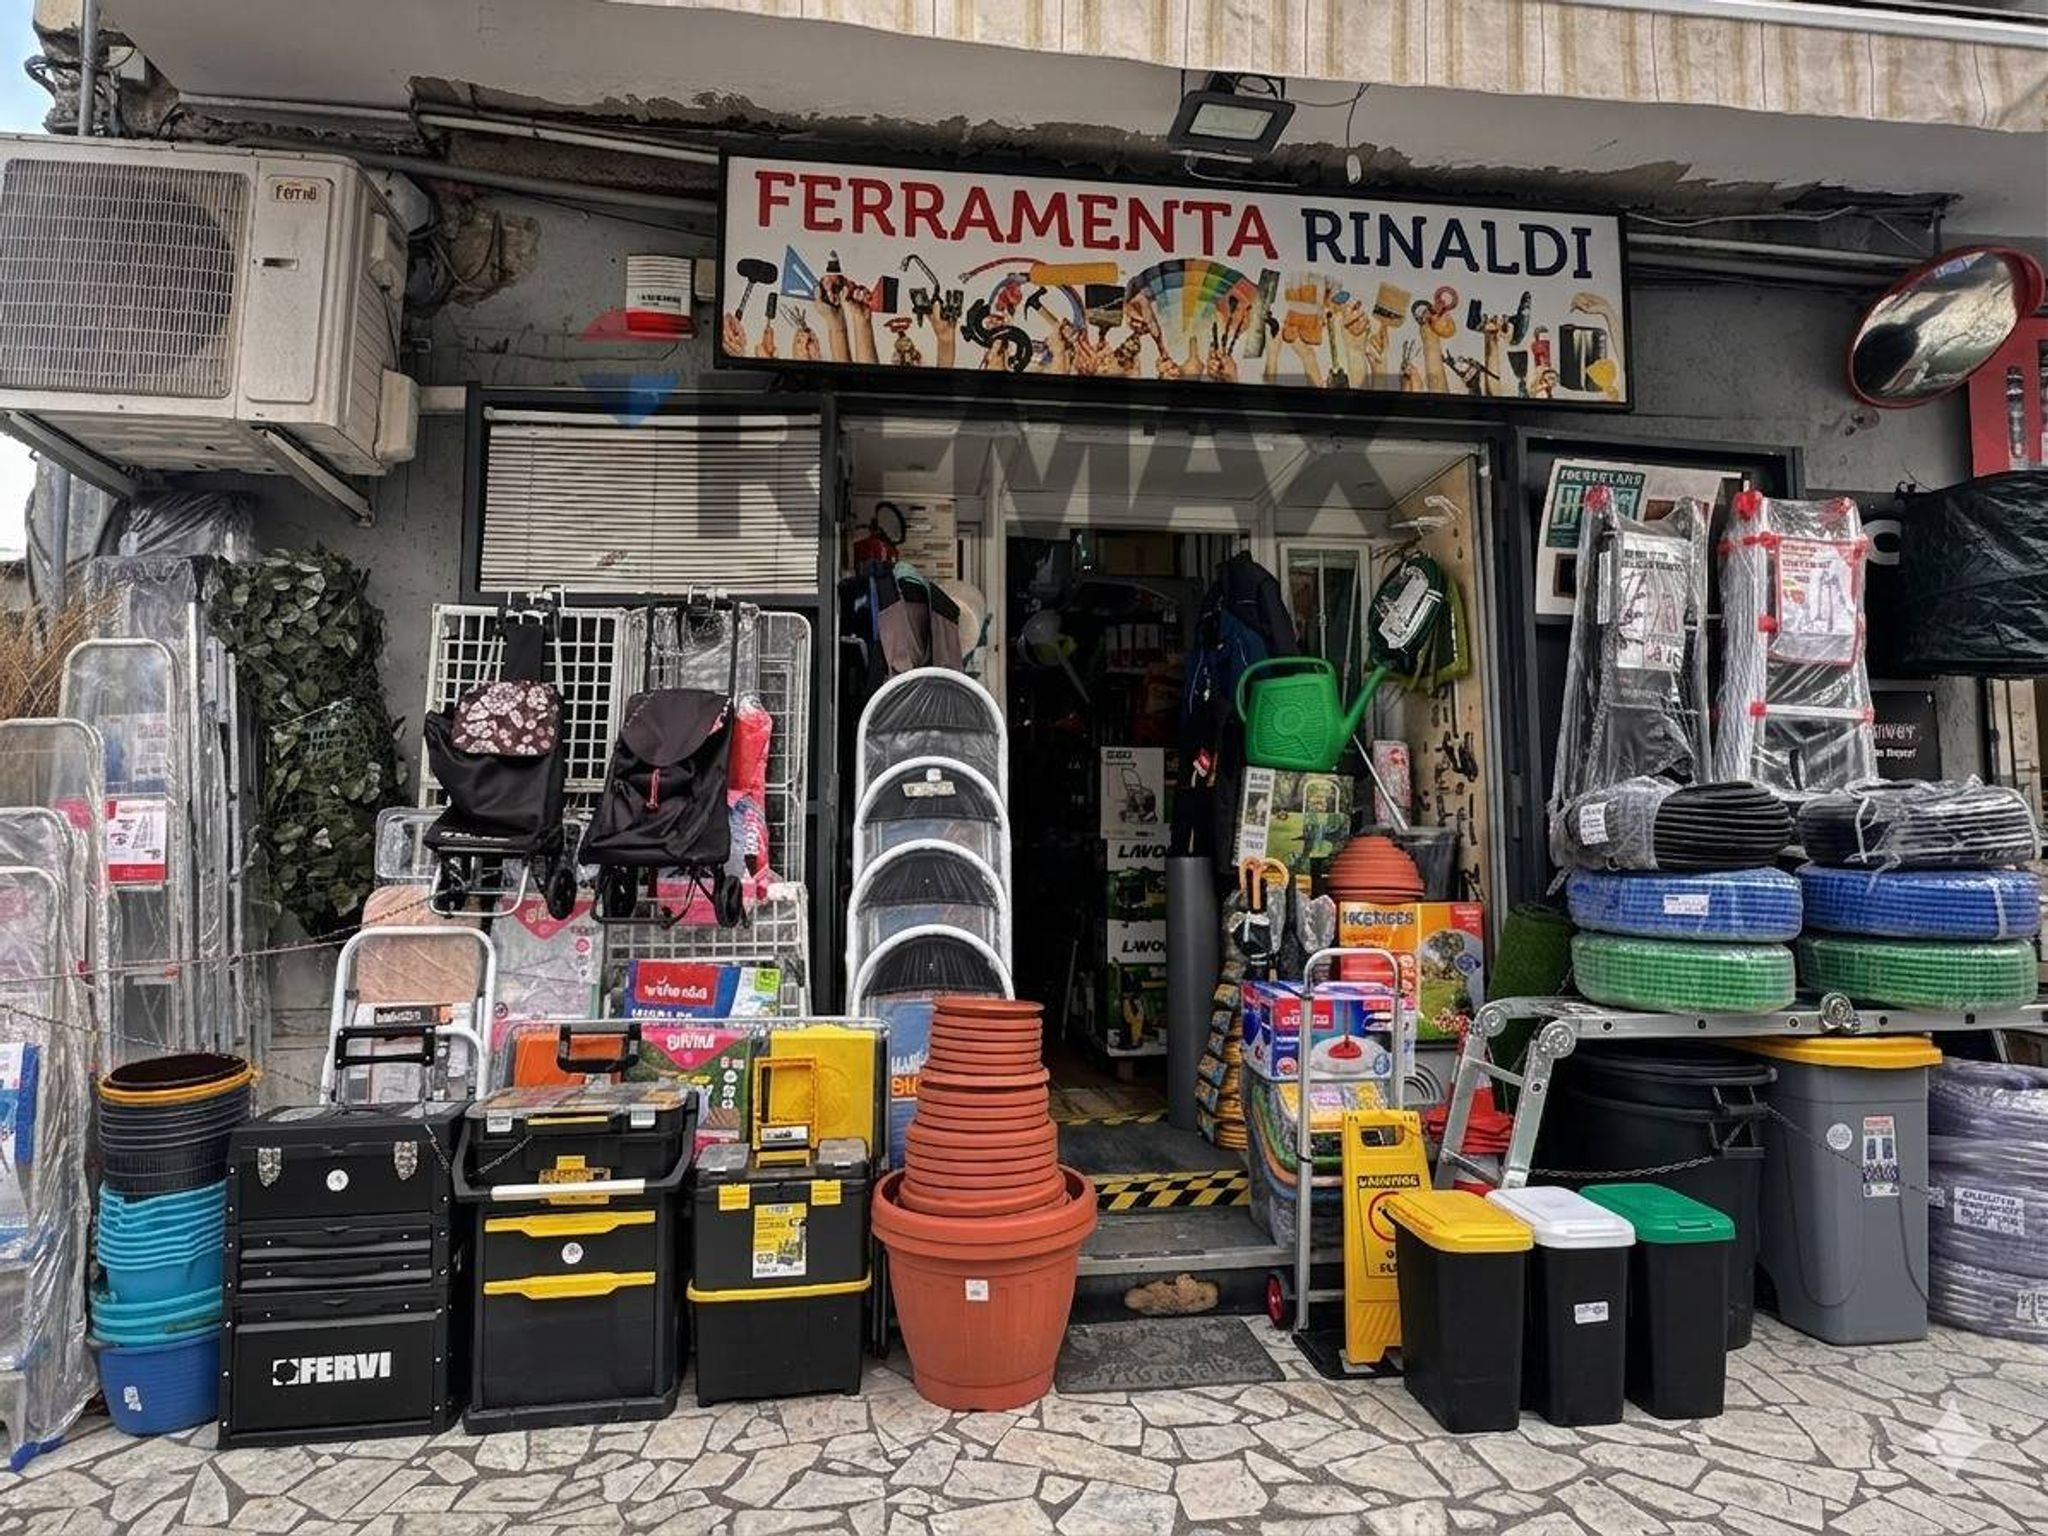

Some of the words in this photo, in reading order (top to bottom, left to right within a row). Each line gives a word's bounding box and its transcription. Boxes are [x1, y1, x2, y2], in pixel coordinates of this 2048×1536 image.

[755, 170, 1279, 260] FERRAMENTA
[1301, 208, 1593, 280] RINALDI
[300, 1351, 391, 1385] FERVI
